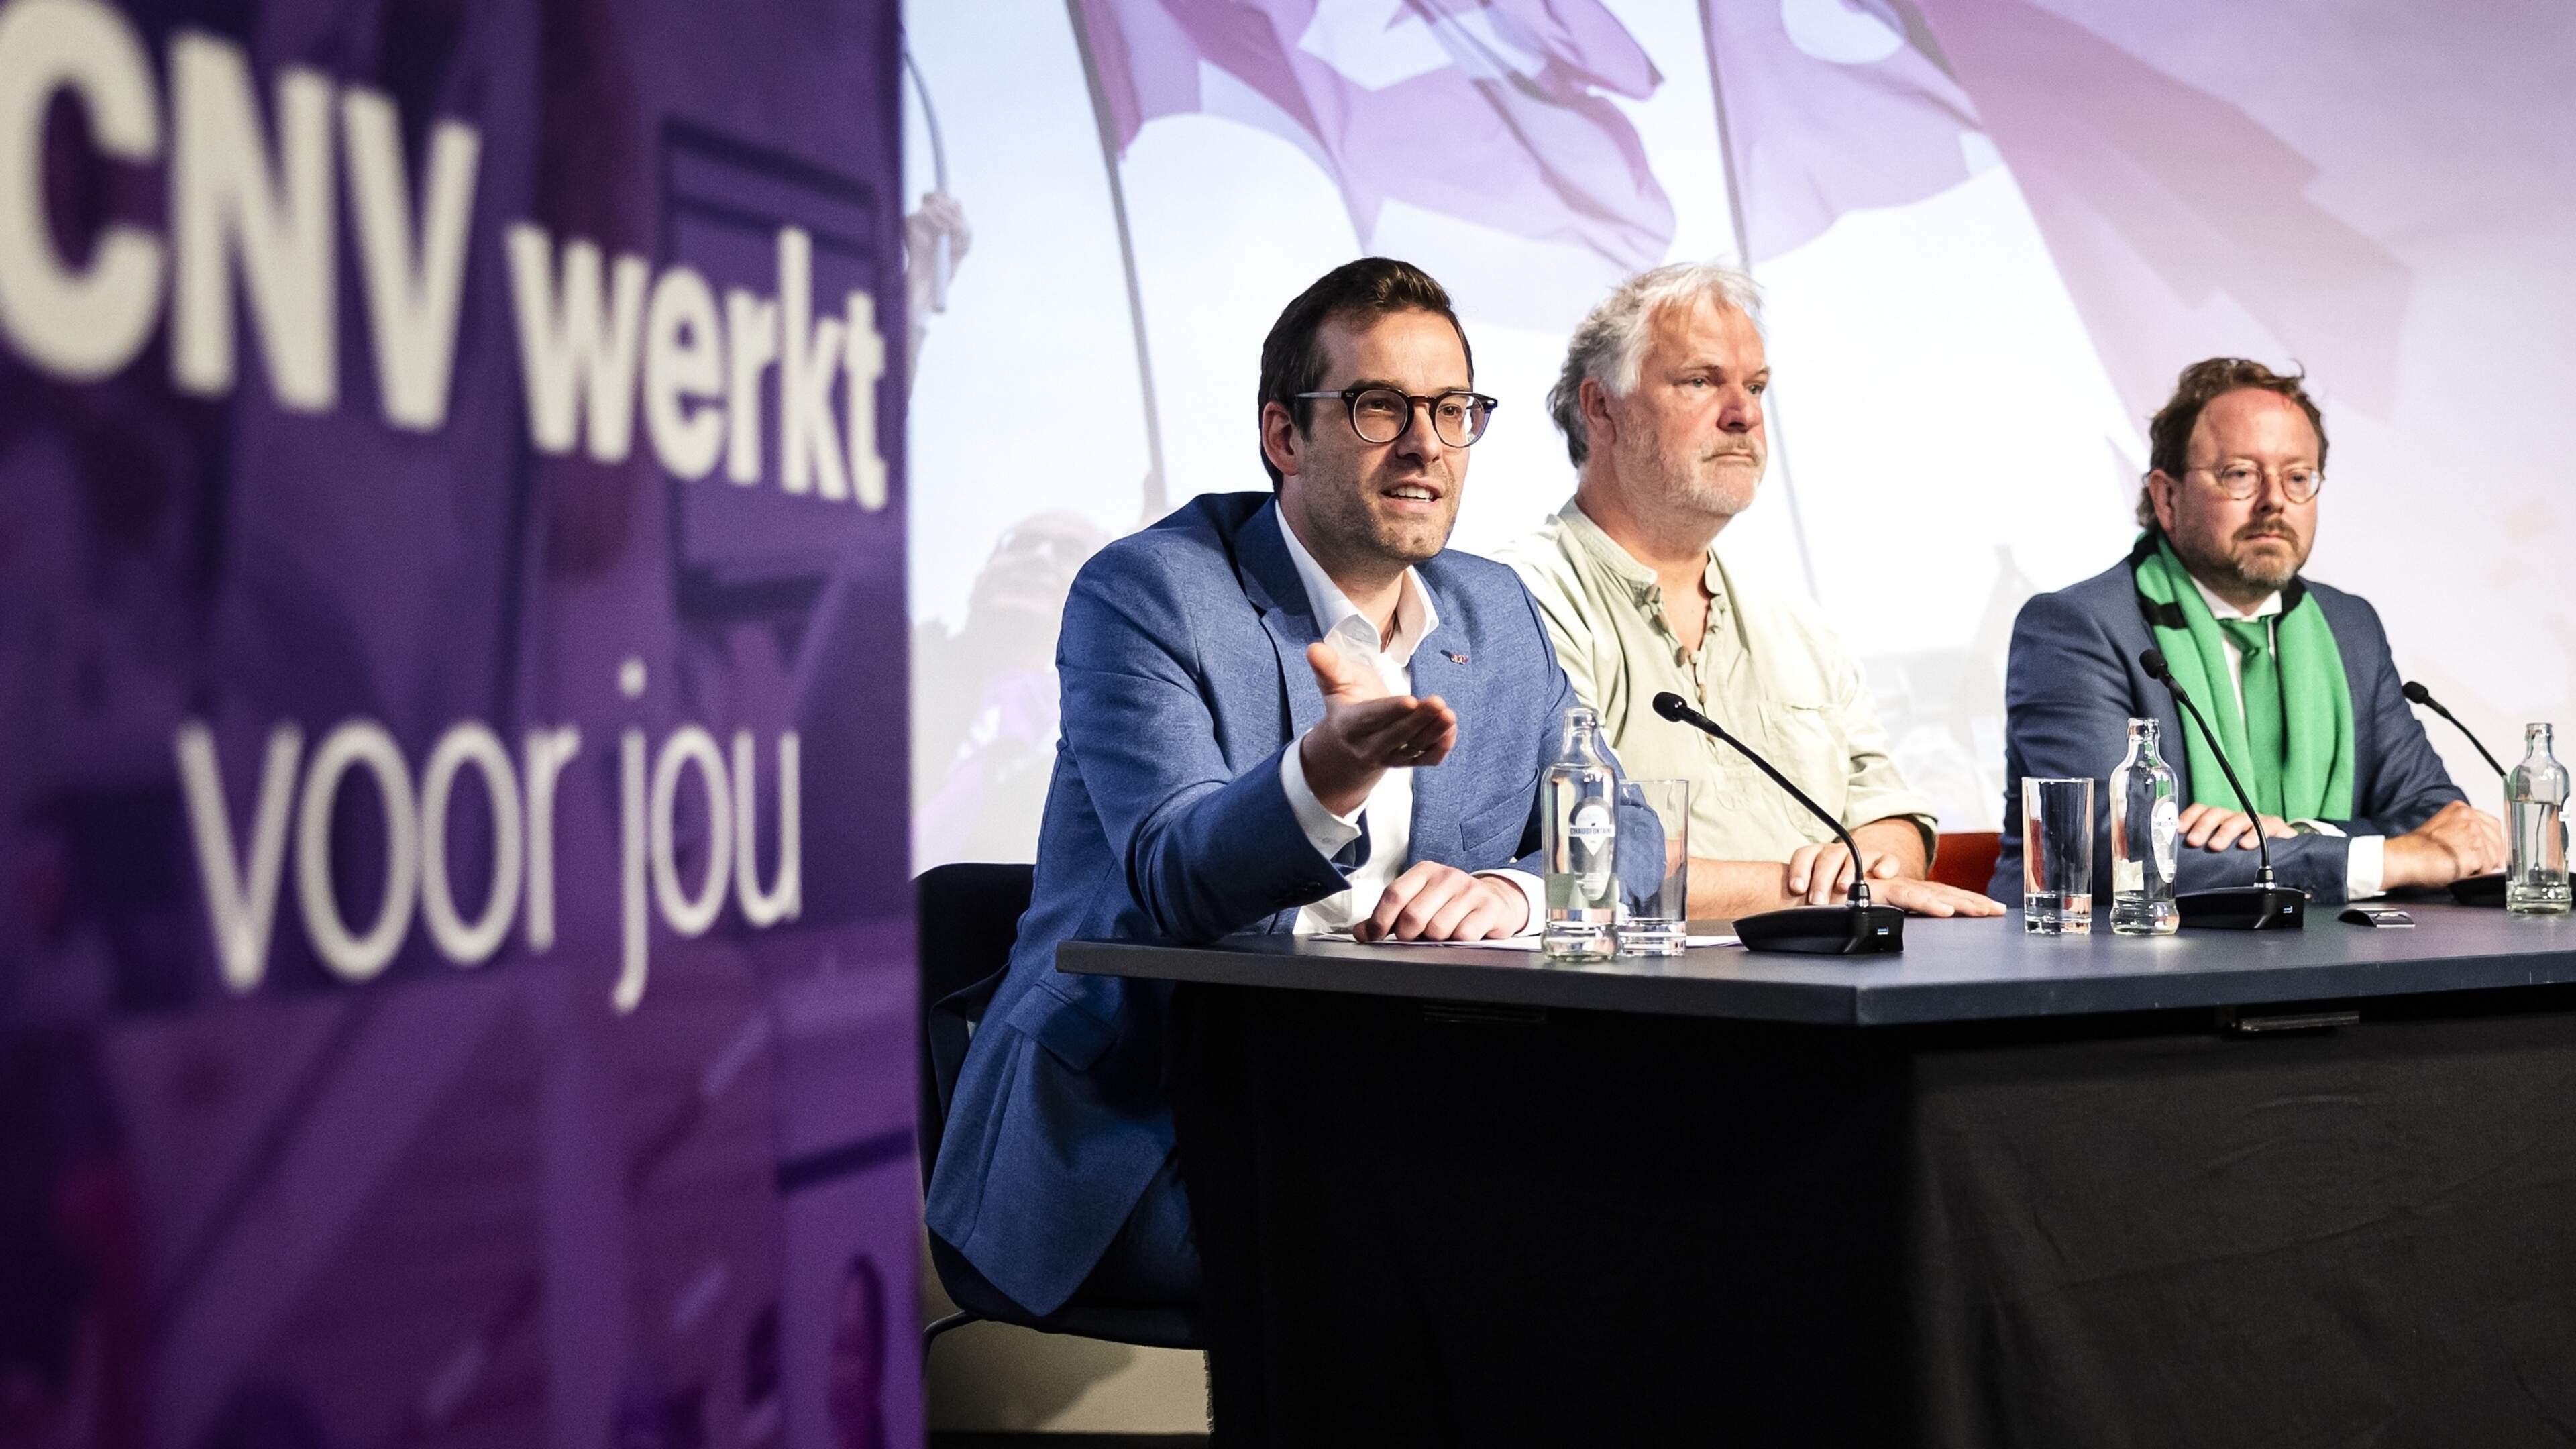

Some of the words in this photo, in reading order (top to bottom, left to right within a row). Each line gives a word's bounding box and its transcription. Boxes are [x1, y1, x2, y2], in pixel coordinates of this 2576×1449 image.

[0, 0, 480, 431] CNV
[506, 224, 890, 514] werkt
[179, 721, 582, 988] voor
[613, 656, 801, 1012] jou
